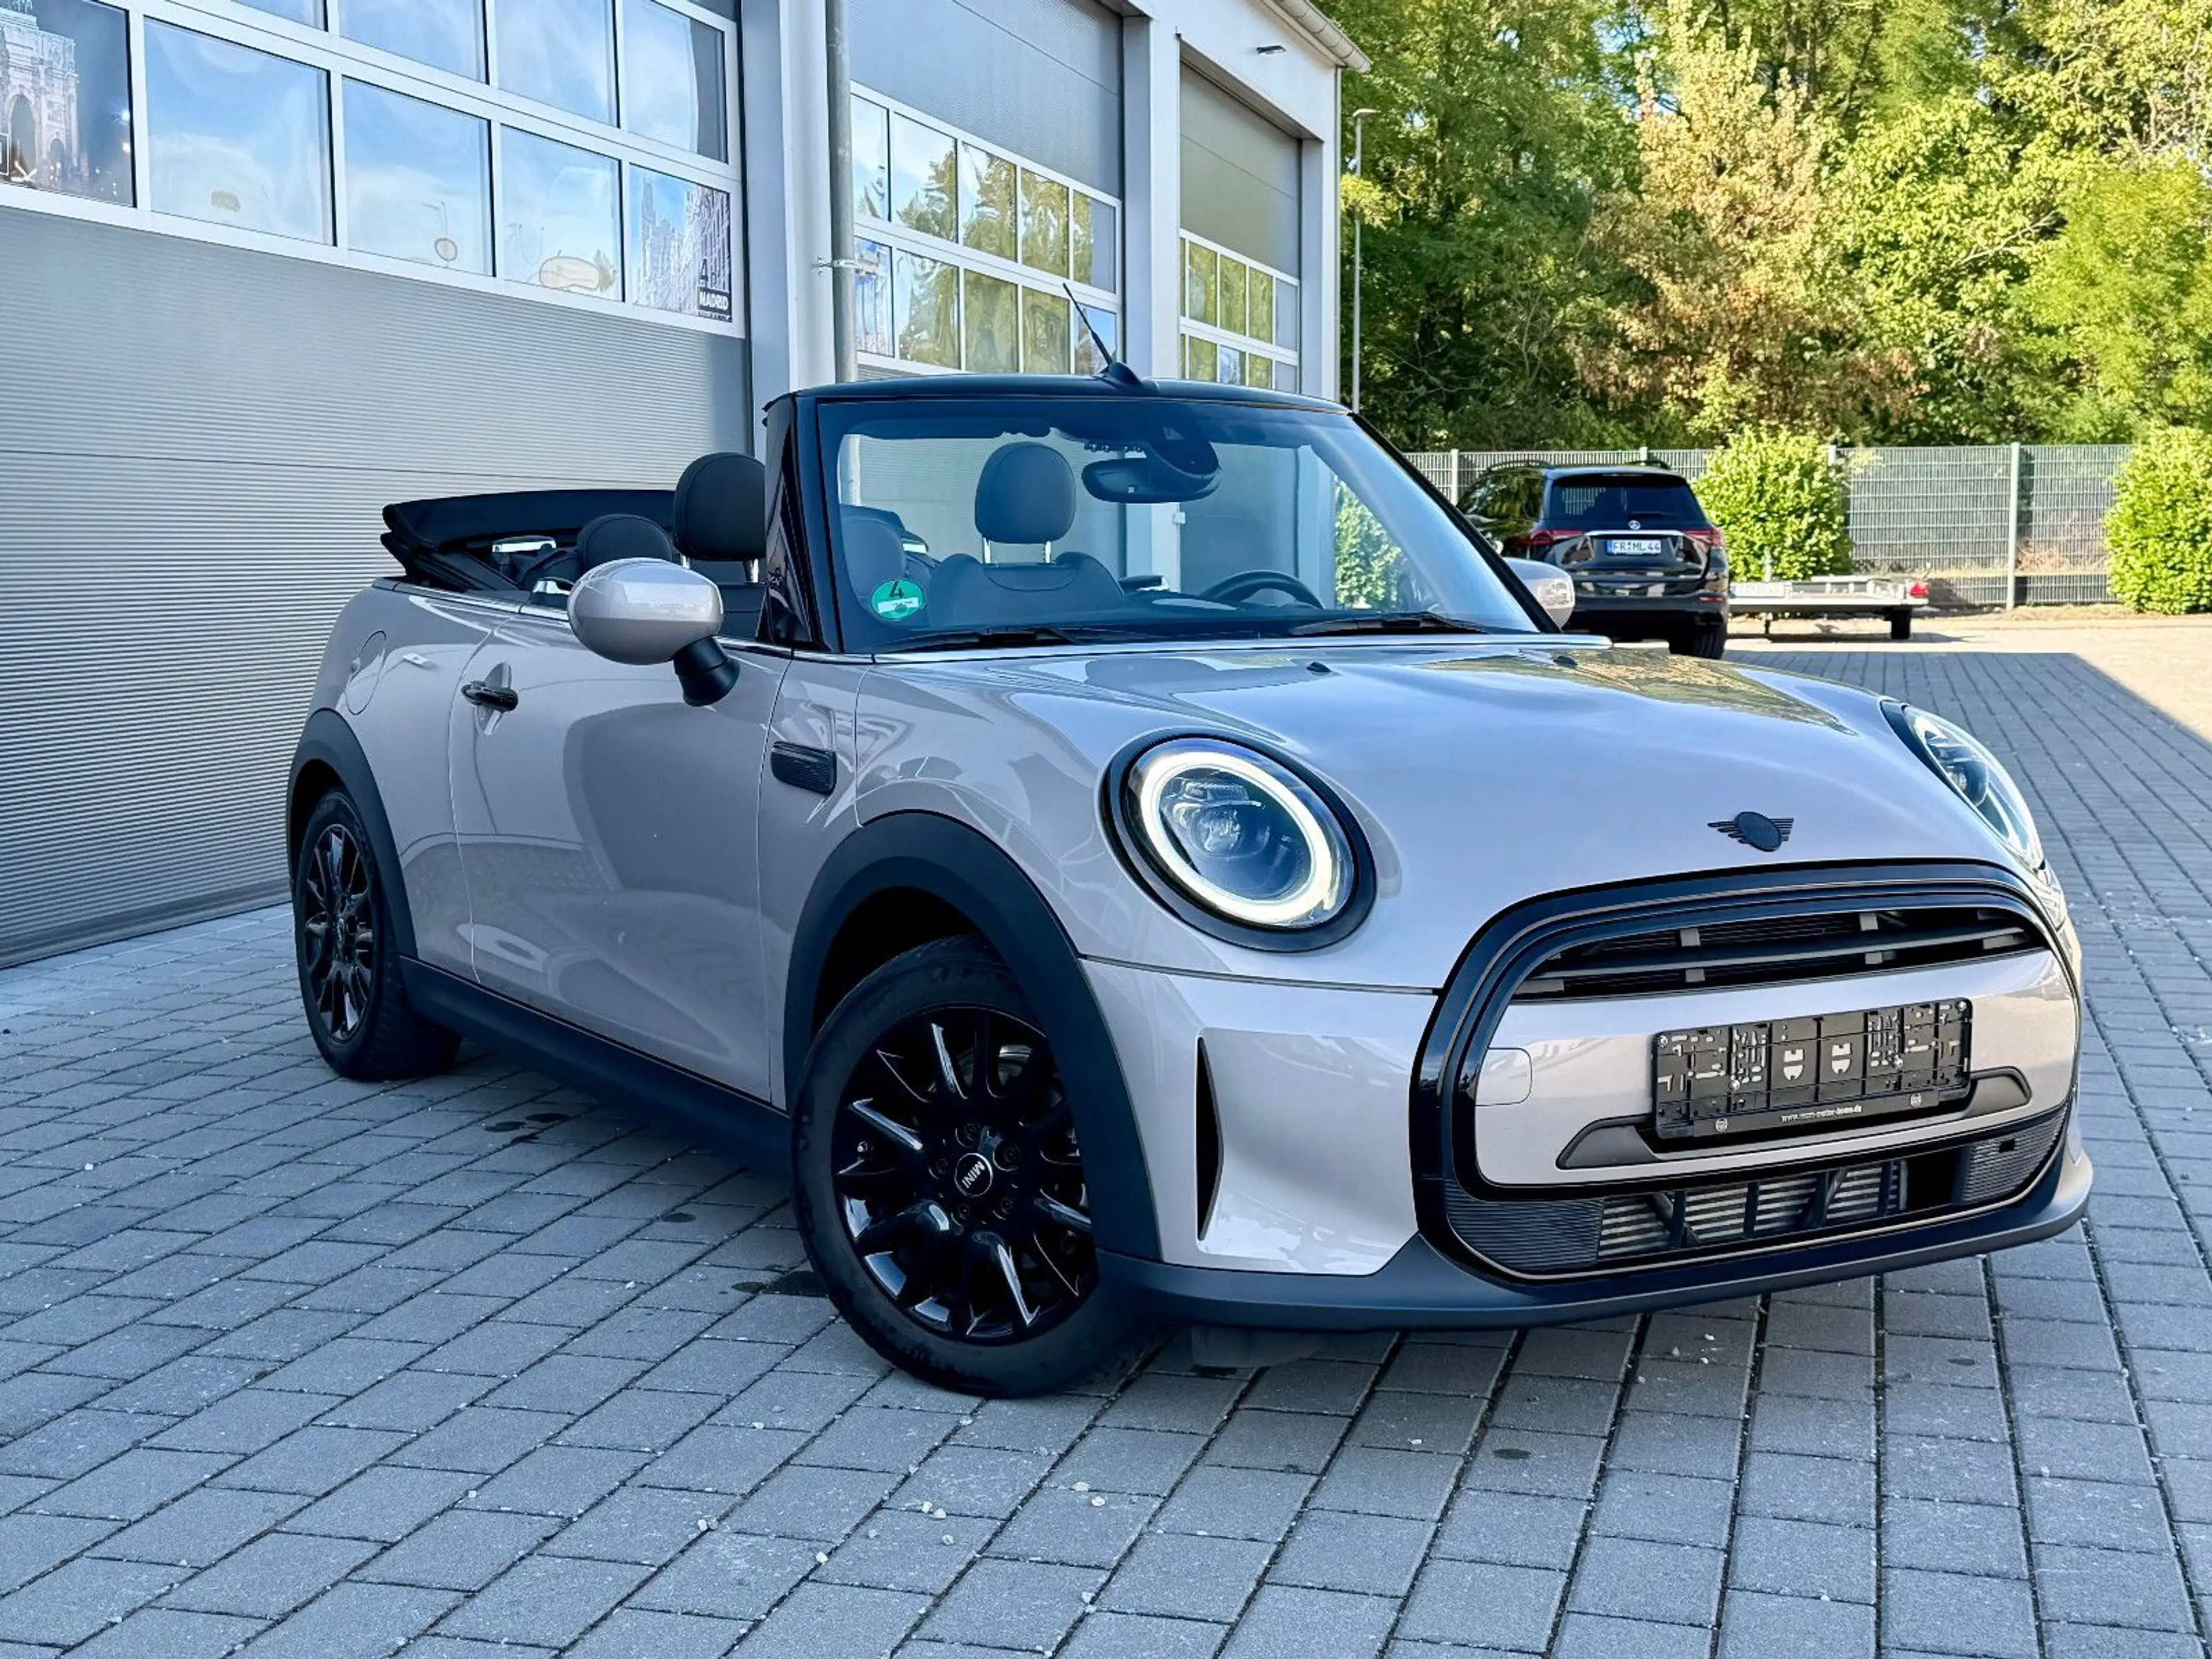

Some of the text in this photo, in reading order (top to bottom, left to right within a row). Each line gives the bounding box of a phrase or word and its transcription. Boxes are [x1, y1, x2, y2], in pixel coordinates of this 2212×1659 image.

[699, 291, 728, 310] MADRID
[889, 580, 904, 598] 4
[961, 1161, 985, 1188] MINI
